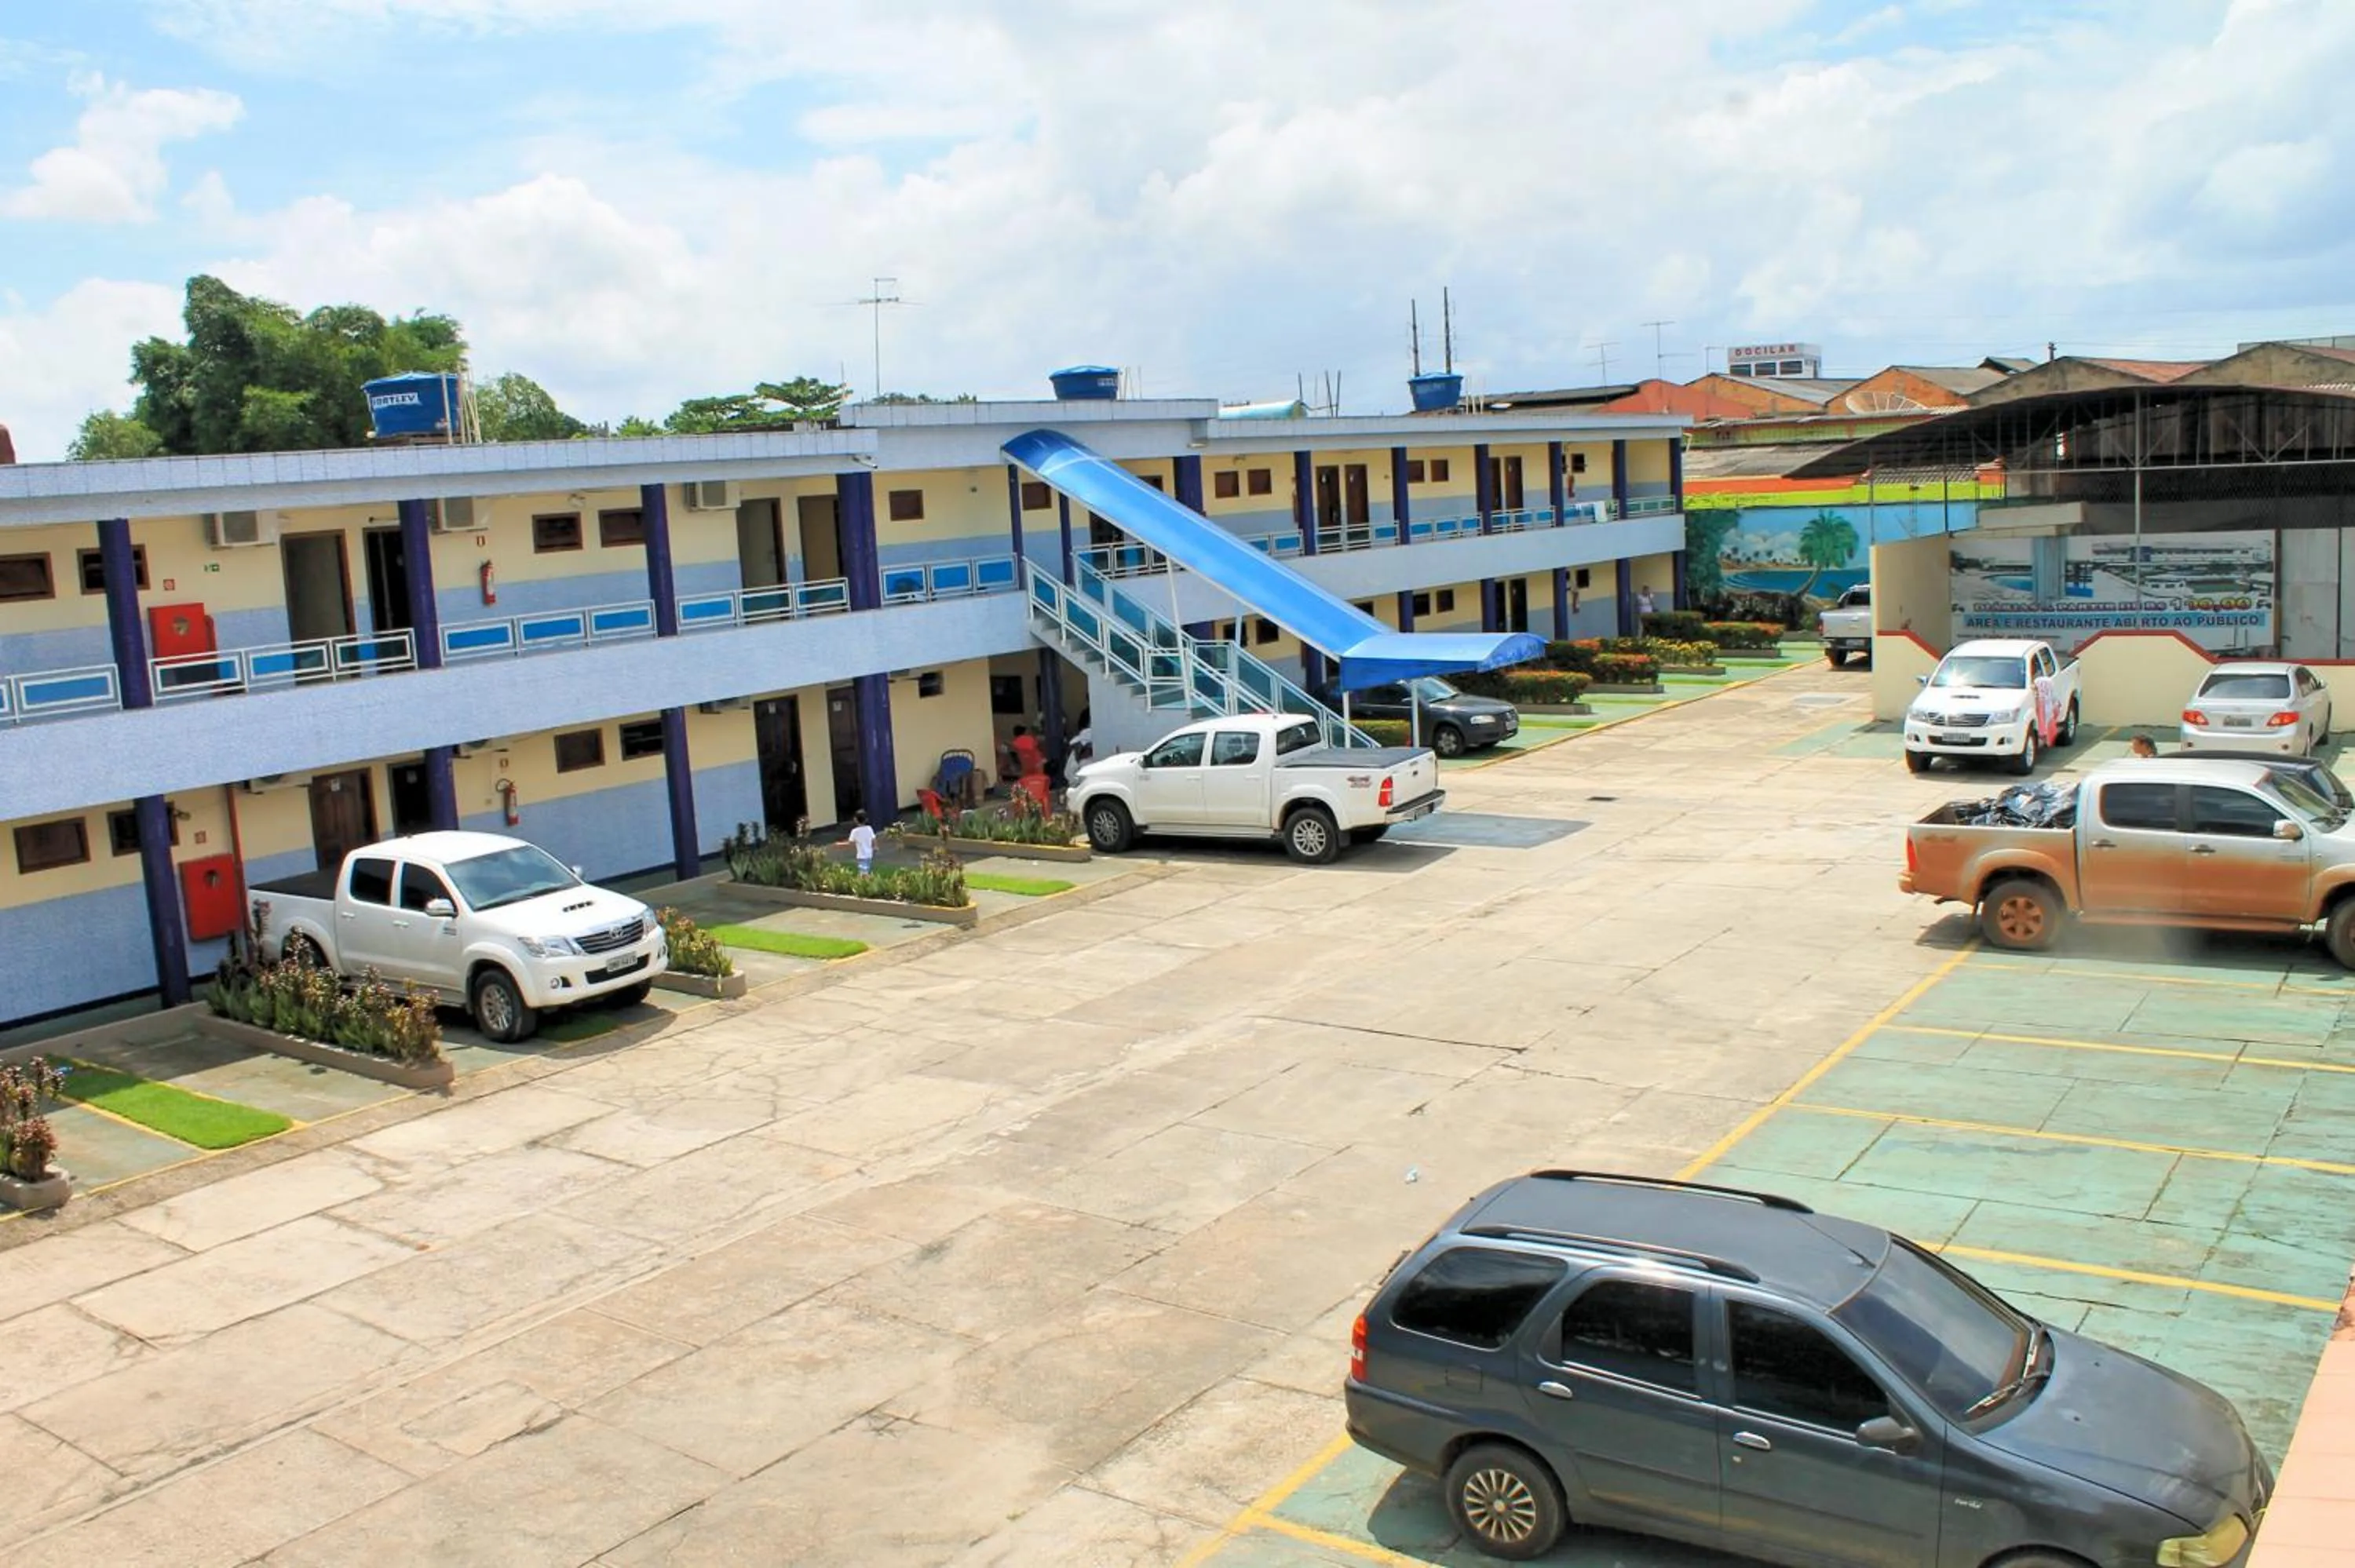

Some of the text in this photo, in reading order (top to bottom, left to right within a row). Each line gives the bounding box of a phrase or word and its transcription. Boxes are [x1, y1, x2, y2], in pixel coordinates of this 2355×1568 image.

[1734, 344, 1795, 356] DOCILAR
[2015, 617, 2110, 628] RESTAURANTE
[2173, 615, 2192, 626] AO
